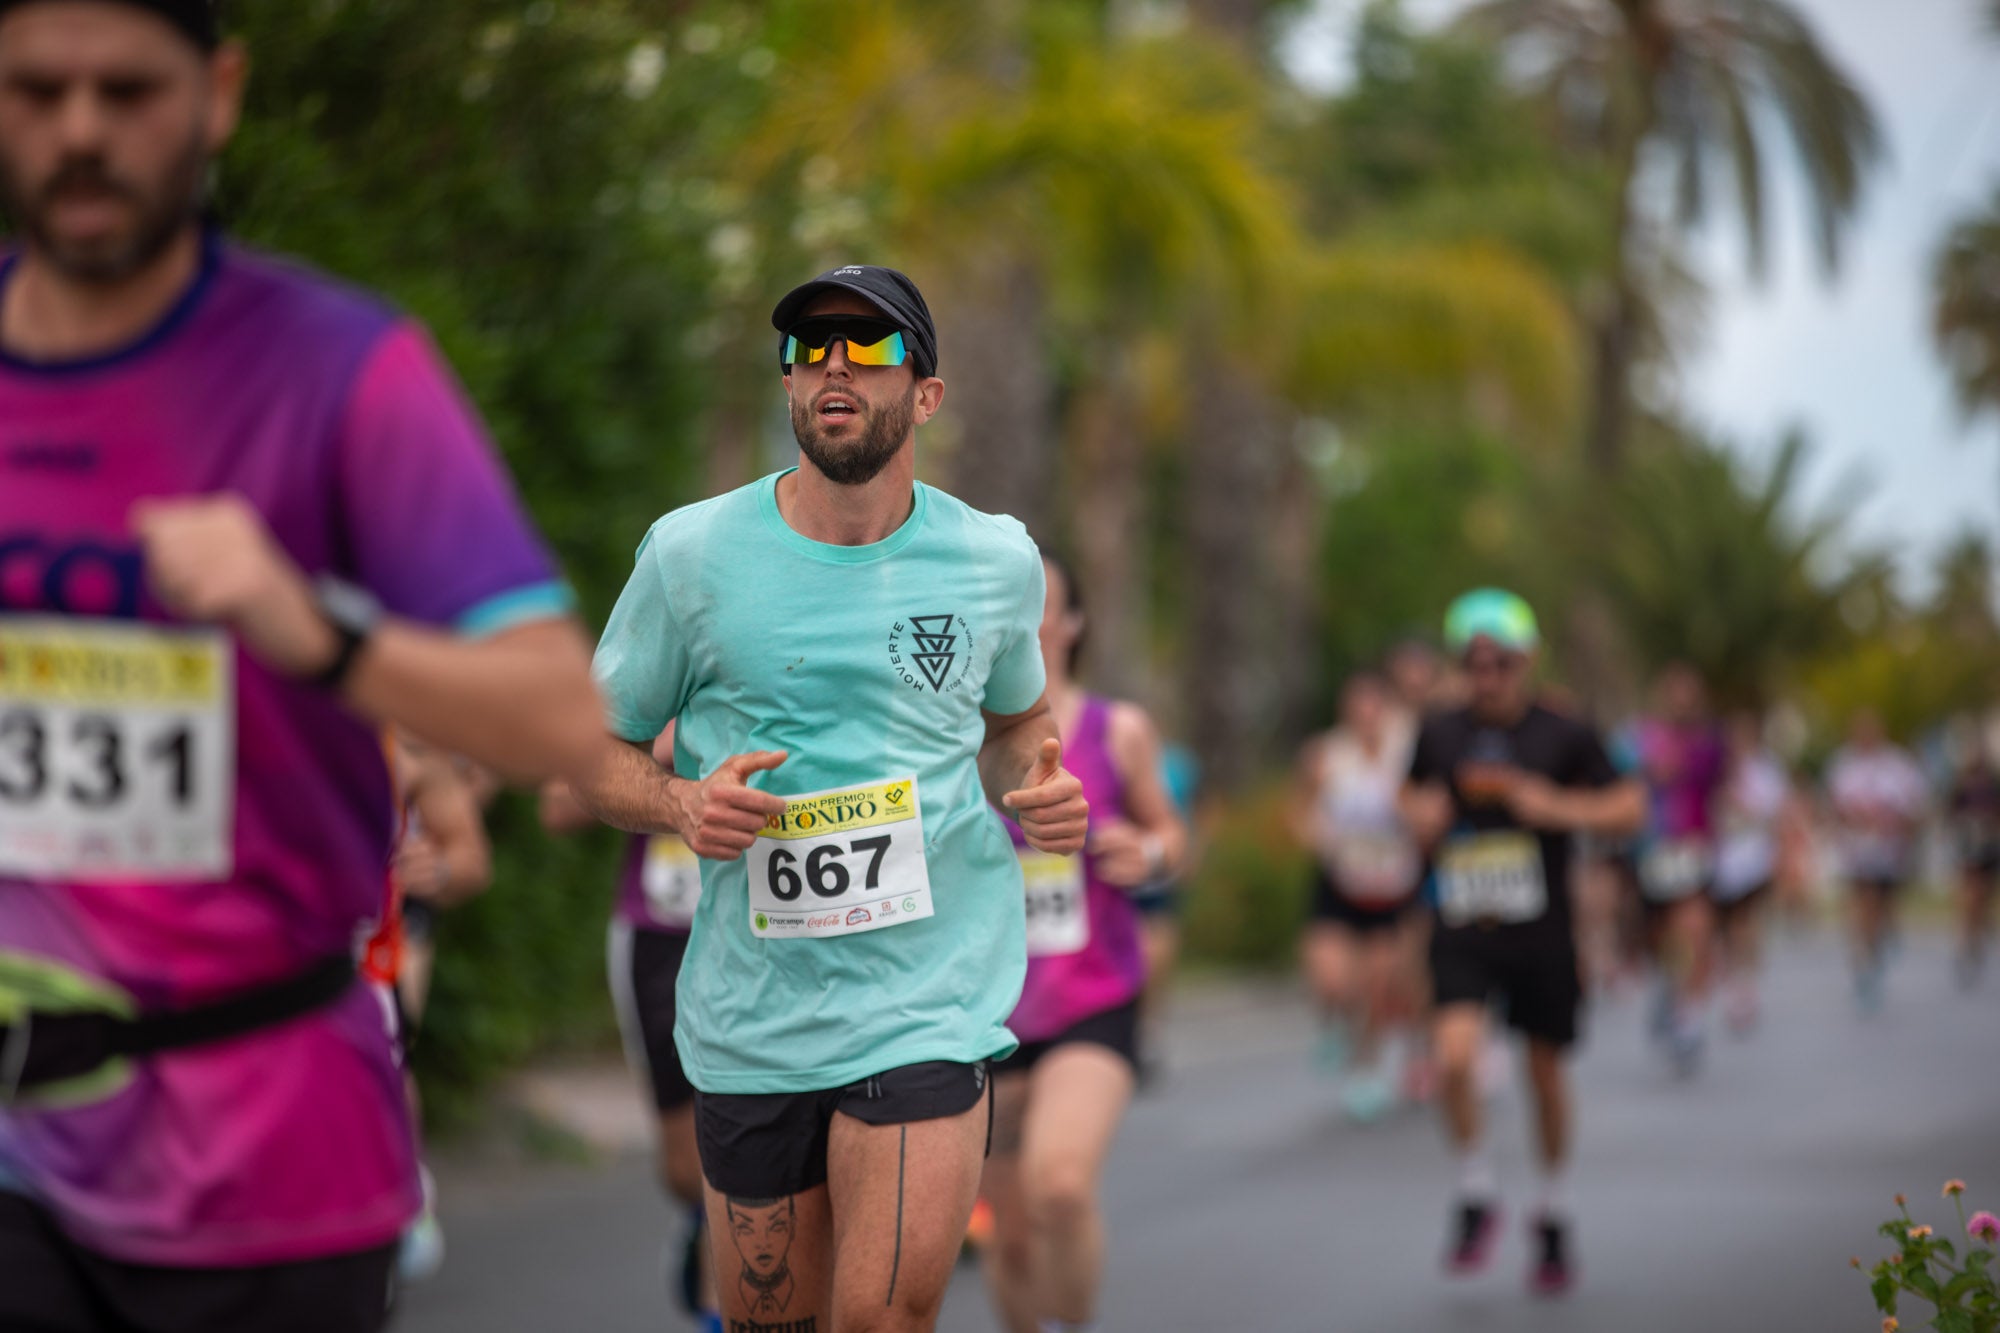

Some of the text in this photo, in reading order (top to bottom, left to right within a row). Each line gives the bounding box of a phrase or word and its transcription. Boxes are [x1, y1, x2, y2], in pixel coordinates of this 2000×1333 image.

[889, 621, 924, 692] MOVERTE
[780, 802, 876, 831] FONDO
[786, 801, 817, 814] GRAN
[820, 793, 866, 807] PREMIO
[768, 834, 892, 901] 667
